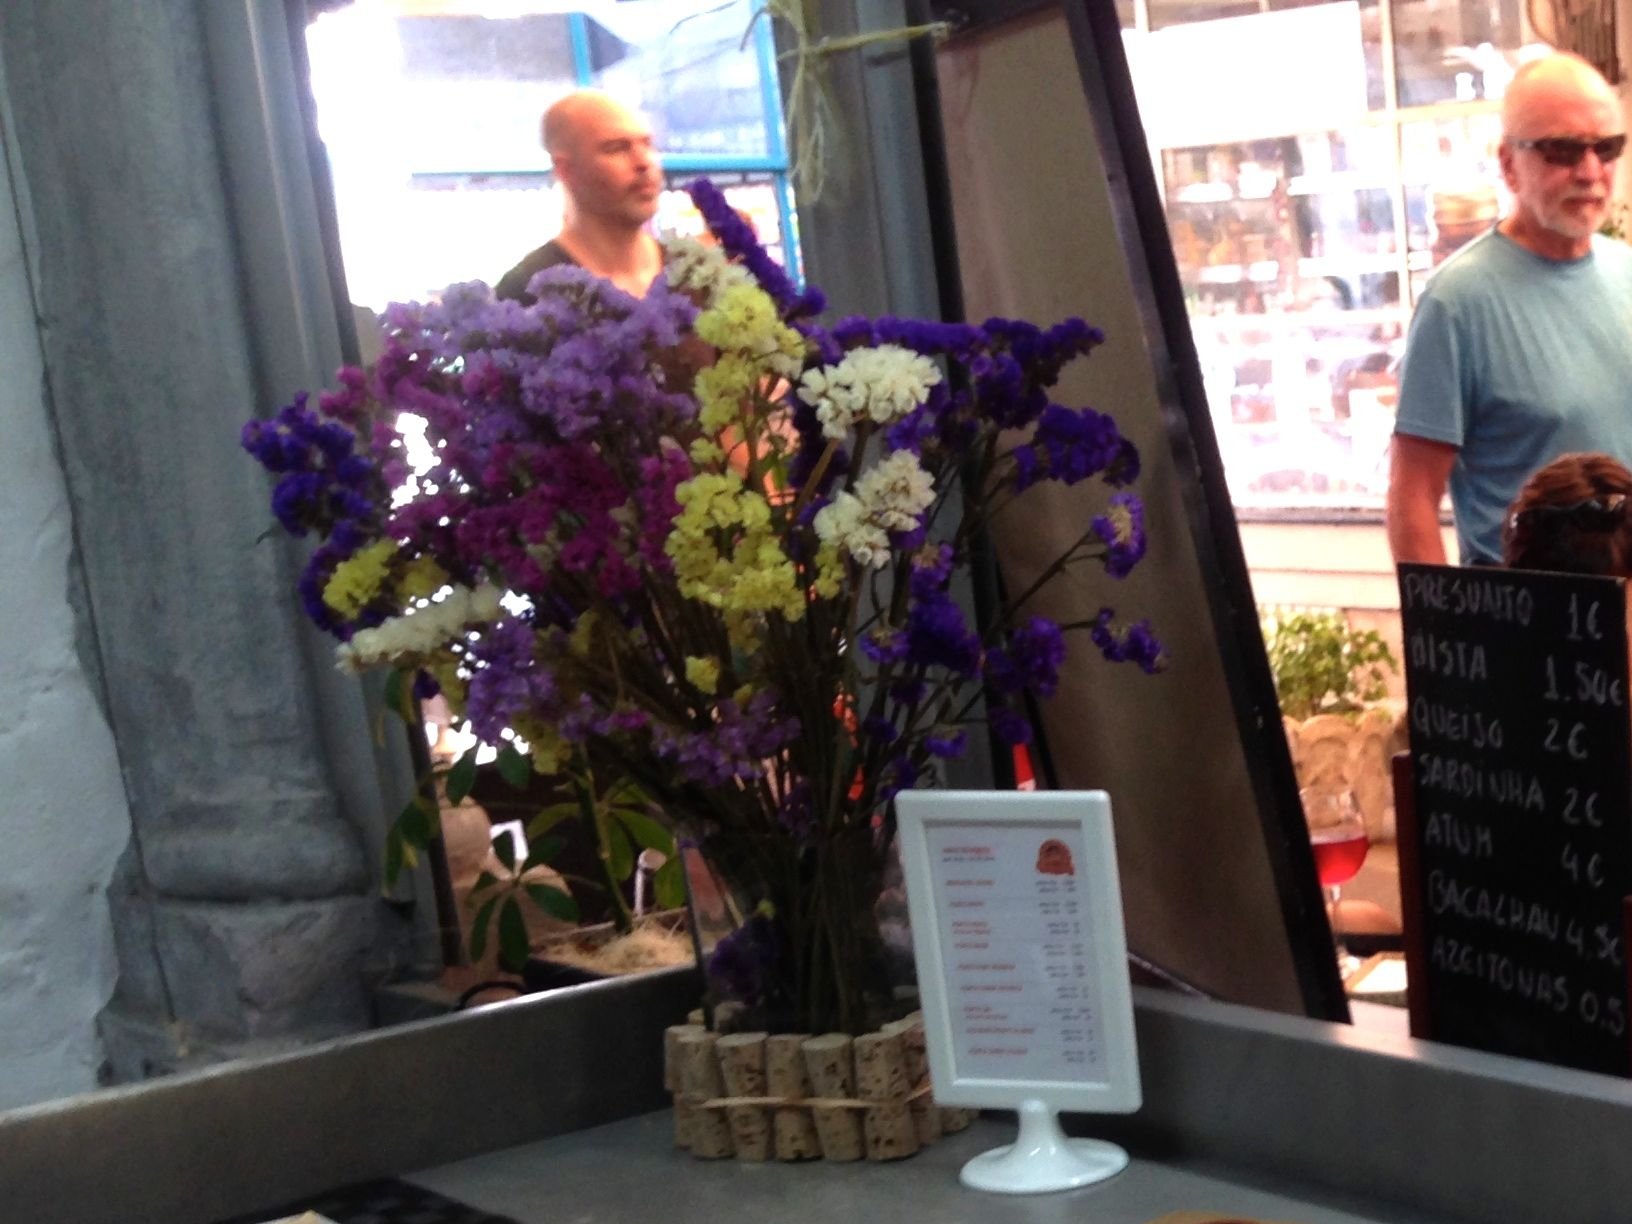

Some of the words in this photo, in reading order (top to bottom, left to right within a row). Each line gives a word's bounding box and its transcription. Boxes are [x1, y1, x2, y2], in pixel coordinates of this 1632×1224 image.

[1405, 573, 1533, 626] PRESUNTO
[1413, 696, 1503, 748] QUEIJO
[1419, 752, 1546, 813] SARDINHA
[1425, 811, 1493, 858] ATUM
[1428, 869, 1560, 940] BACALHAU
[1432, 935, 1569, 1013] AZEITONAS
